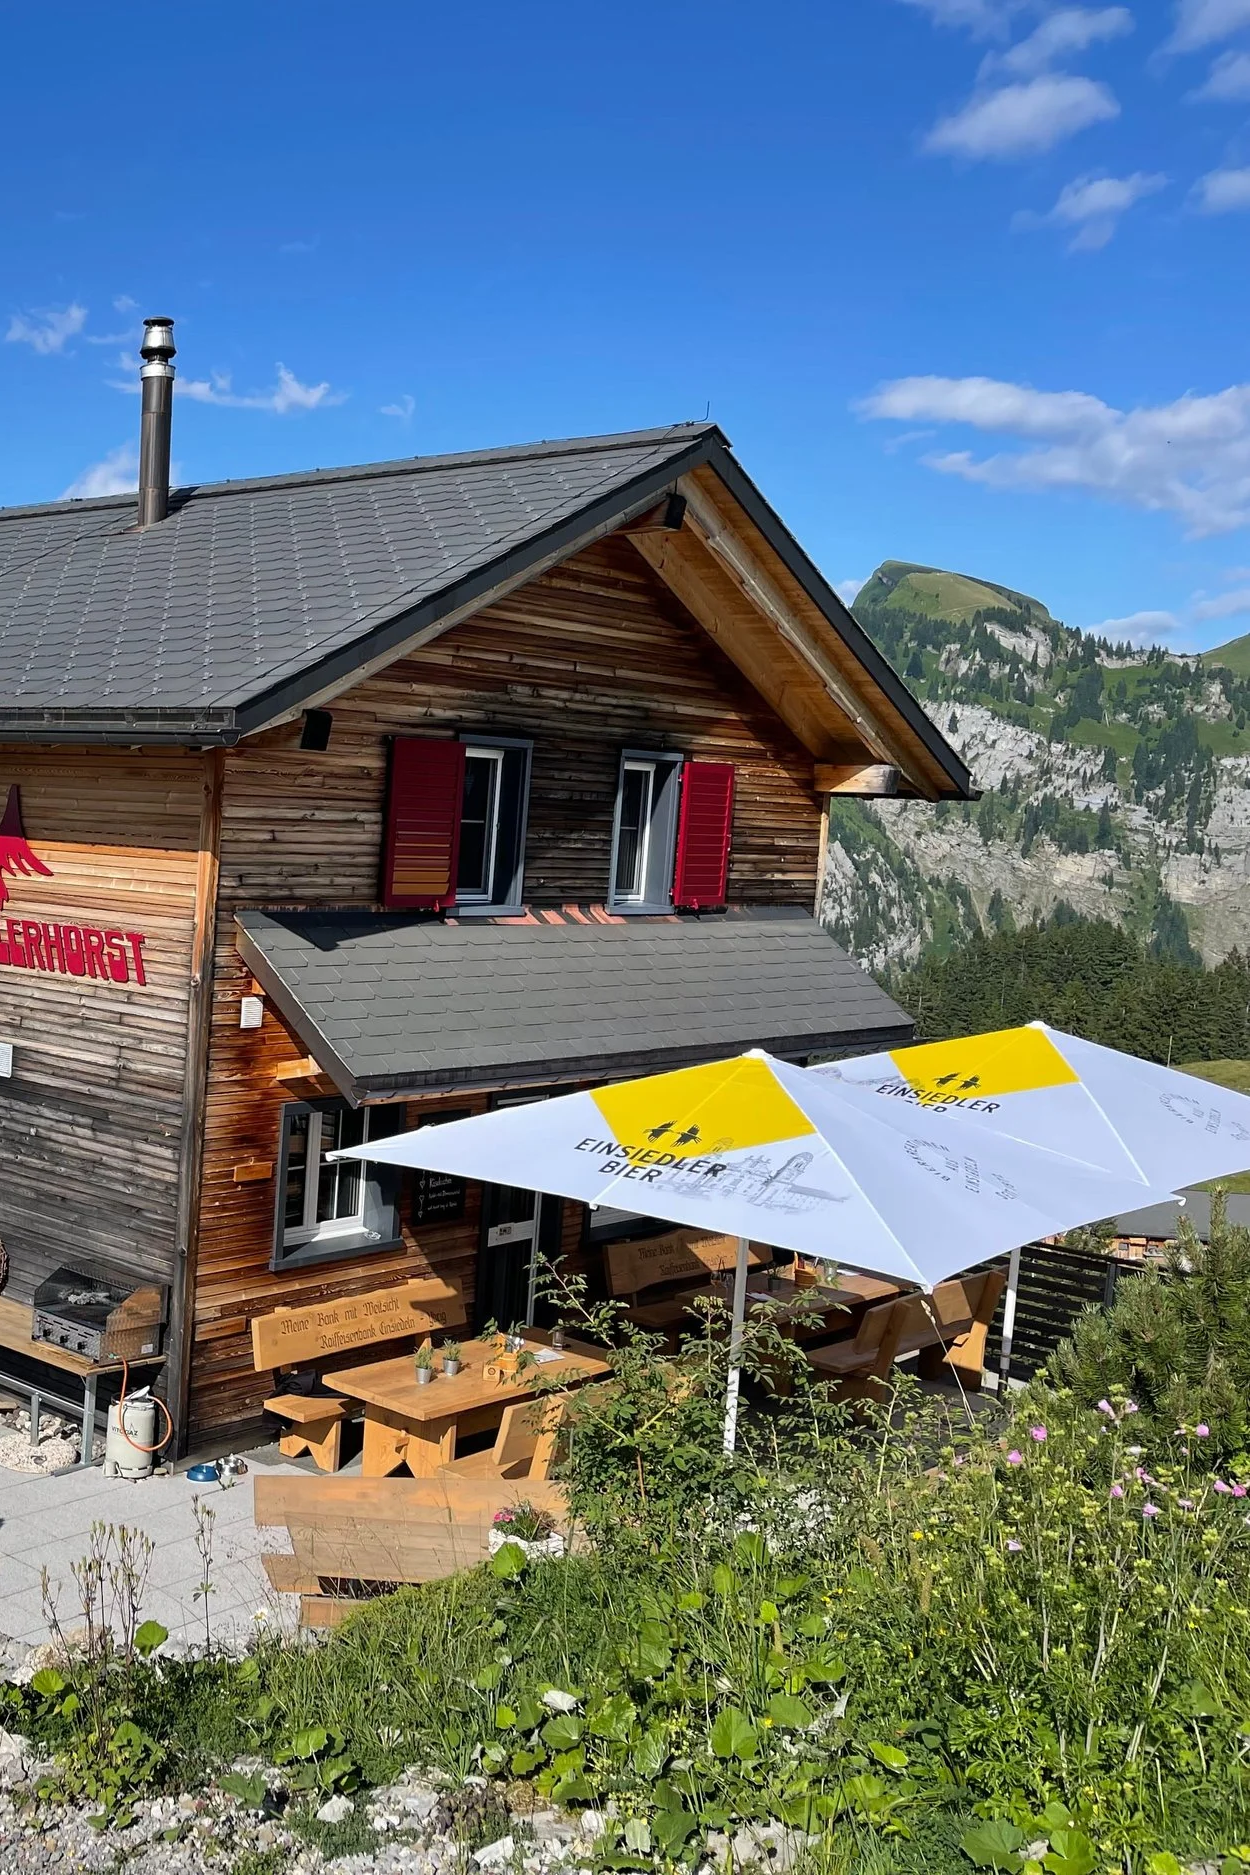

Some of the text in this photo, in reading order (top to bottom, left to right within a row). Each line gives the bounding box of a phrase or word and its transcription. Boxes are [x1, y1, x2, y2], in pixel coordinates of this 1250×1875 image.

[875, 1084, 1001, 1113] EINSIEDLER
[574, 1138, 727, 1177] EINSIEDLER
[598, 1160, 662, 1183] BIER
[281, 1296, 400, 1335] Meine Bank mit Weitsicht
[320, 1324, 377, 1349] Raiffeisenbank
[378, 1317, 416, 1335] Einsiedeln
